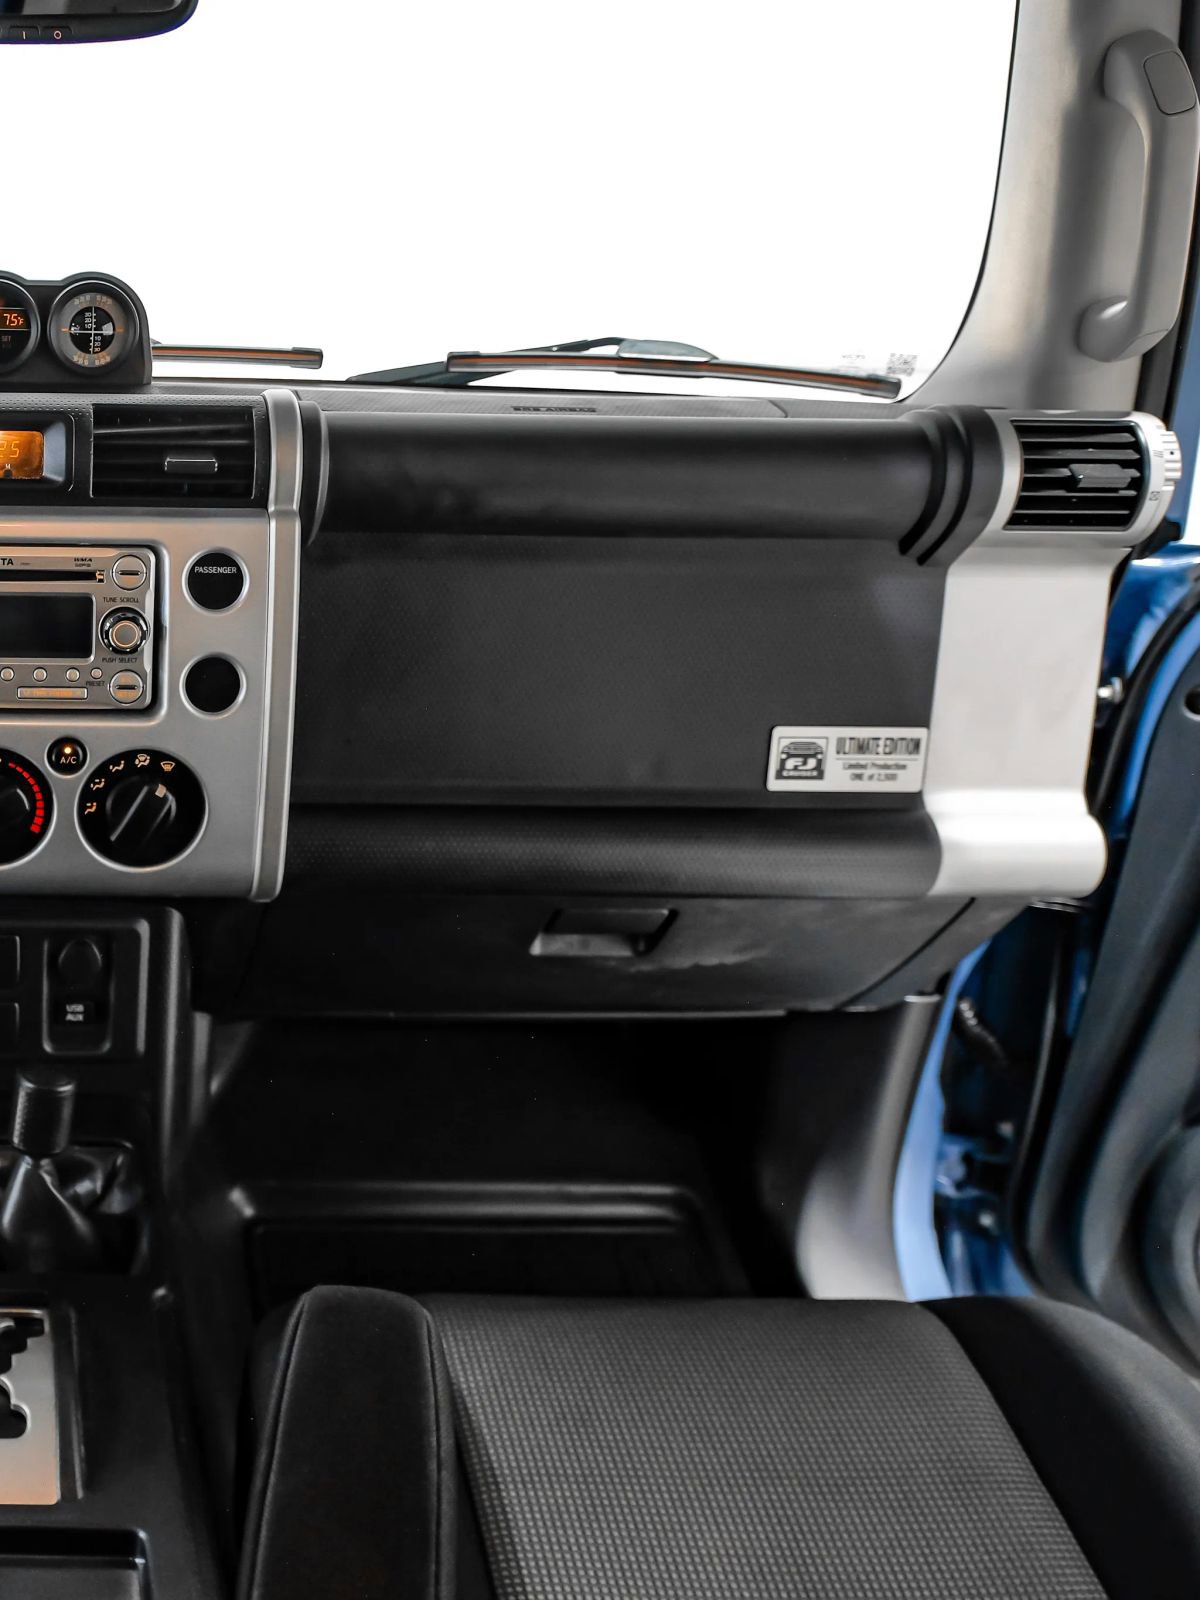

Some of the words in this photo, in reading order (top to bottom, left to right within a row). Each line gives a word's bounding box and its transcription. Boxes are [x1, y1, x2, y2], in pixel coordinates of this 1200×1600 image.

[194, 566, 237, 574] PASSENGER
[836, 736, 881, 755] ULTIMATE
[882, 737, 921, 755] EDITION
[59, 756, 77, 764] A/C
[784, 757, 817, 770] FJ
